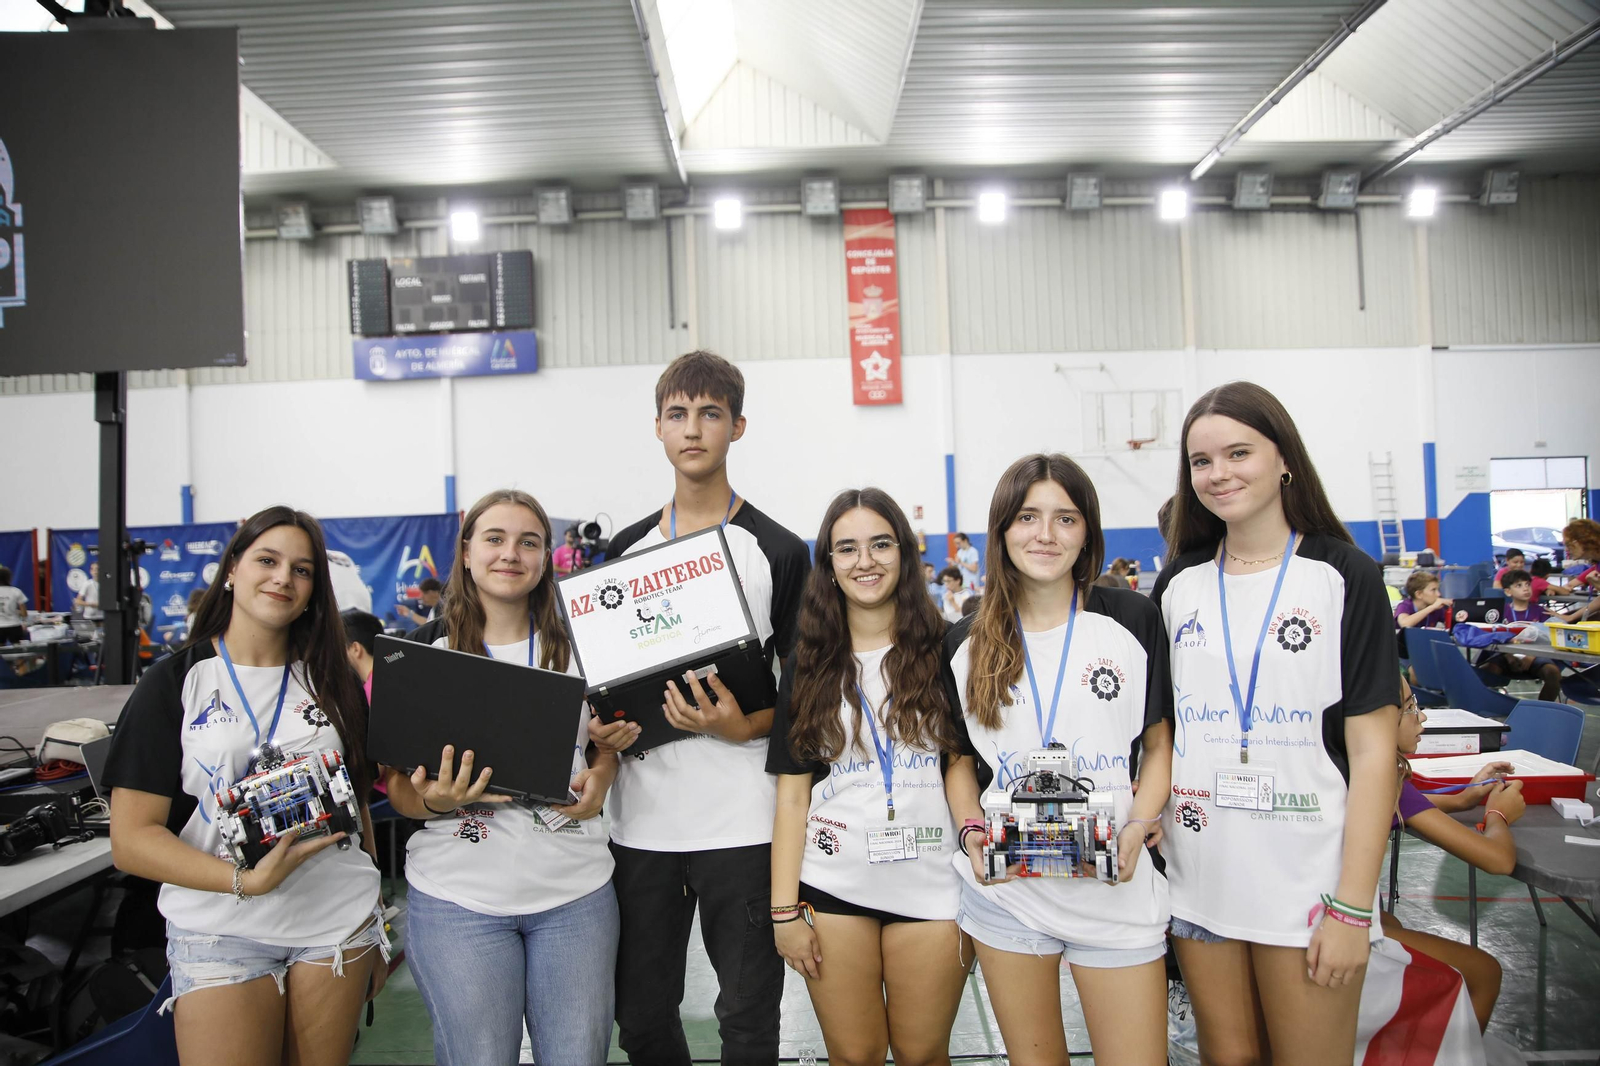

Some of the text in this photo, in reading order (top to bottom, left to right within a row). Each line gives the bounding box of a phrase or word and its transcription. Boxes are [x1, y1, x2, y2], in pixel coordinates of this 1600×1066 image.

[395, 276, 422, 288] LOCAL
[571, 594, 595, 618] AZ
[629, 552, 724, 598] ZAITEROS
[634, 584, 683, 605] ROBOTICS TEAM
[1268, 622, 1278, 635] IES
[384, 650, 404, 664] ThinkPad
[1081, 673, 1089, 686] IES
[1204, 733, 1230, 744] Centro
[1250, 812, 1324, 822] CARPINTEROS
